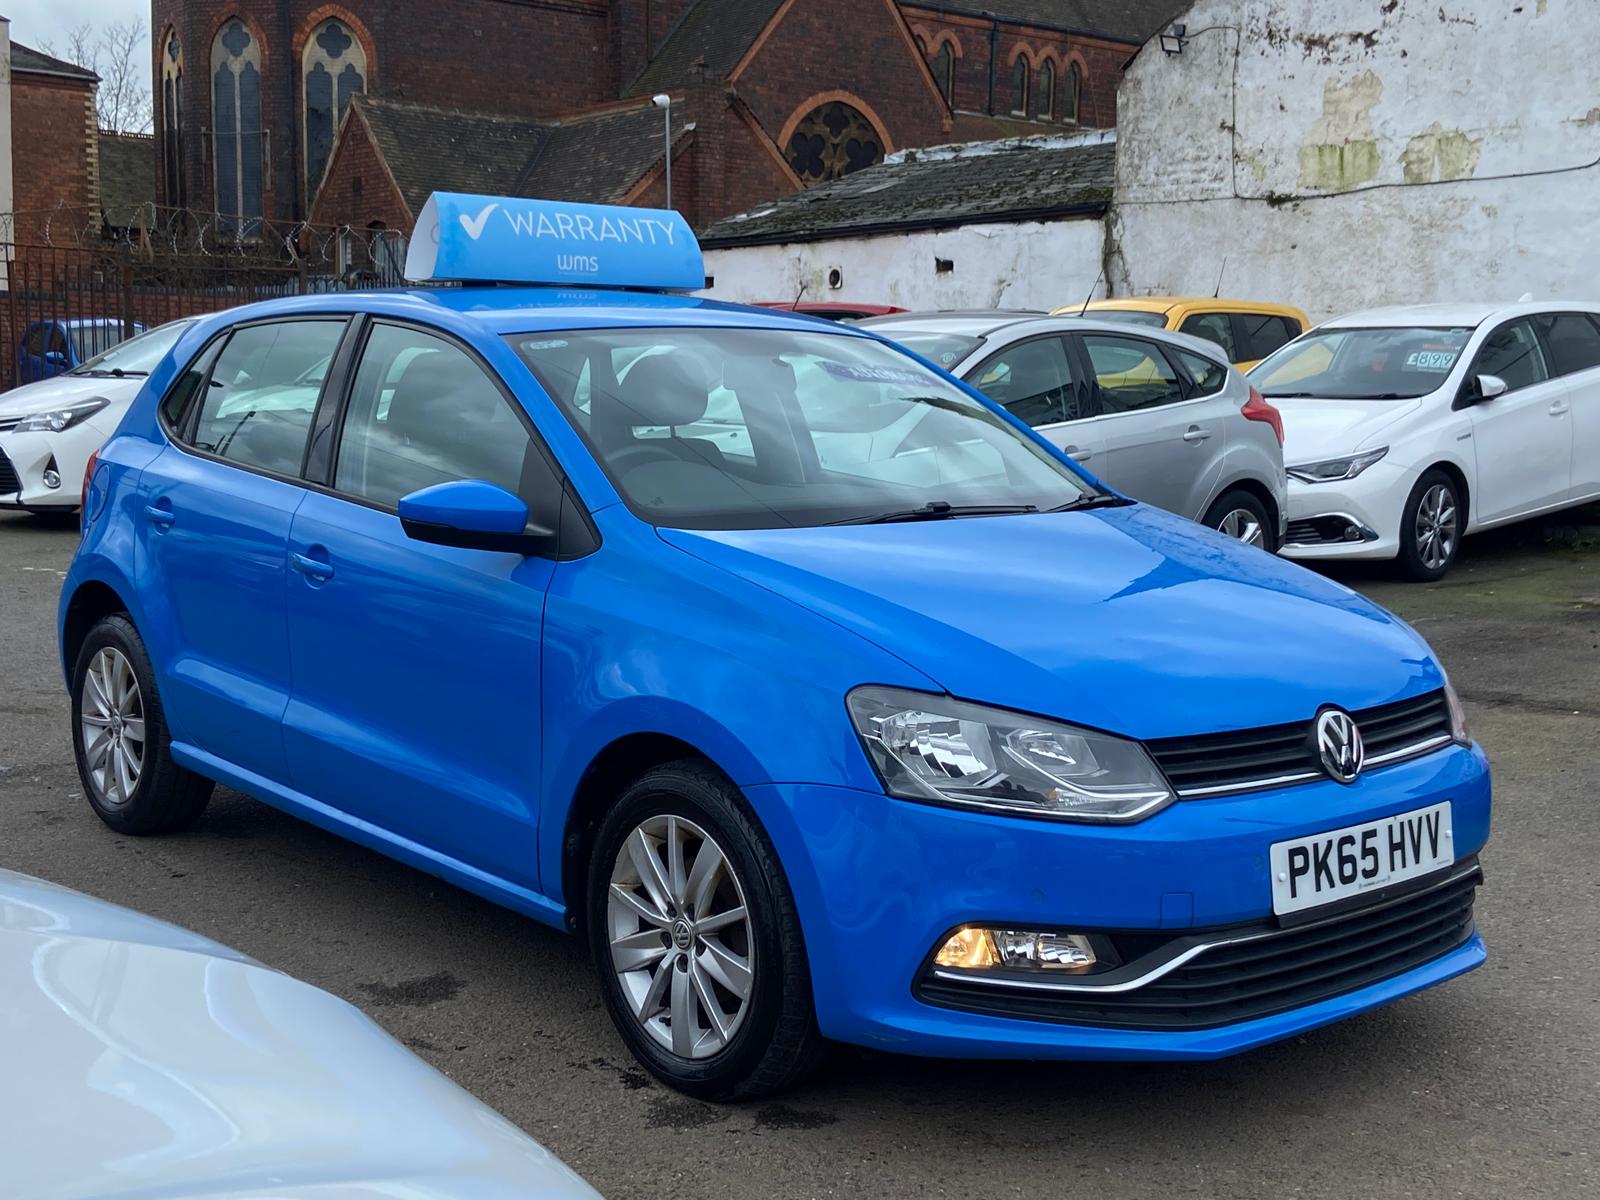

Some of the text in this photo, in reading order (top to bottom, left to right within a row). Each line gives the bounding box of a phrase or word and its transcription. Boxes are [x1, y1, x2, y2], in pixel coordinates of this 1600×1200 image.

[503, 208, 675, 245] WARRANTY
[557, 254, 599, 272] wms
[1287, 810, 1440, 899] PK65 HVV
